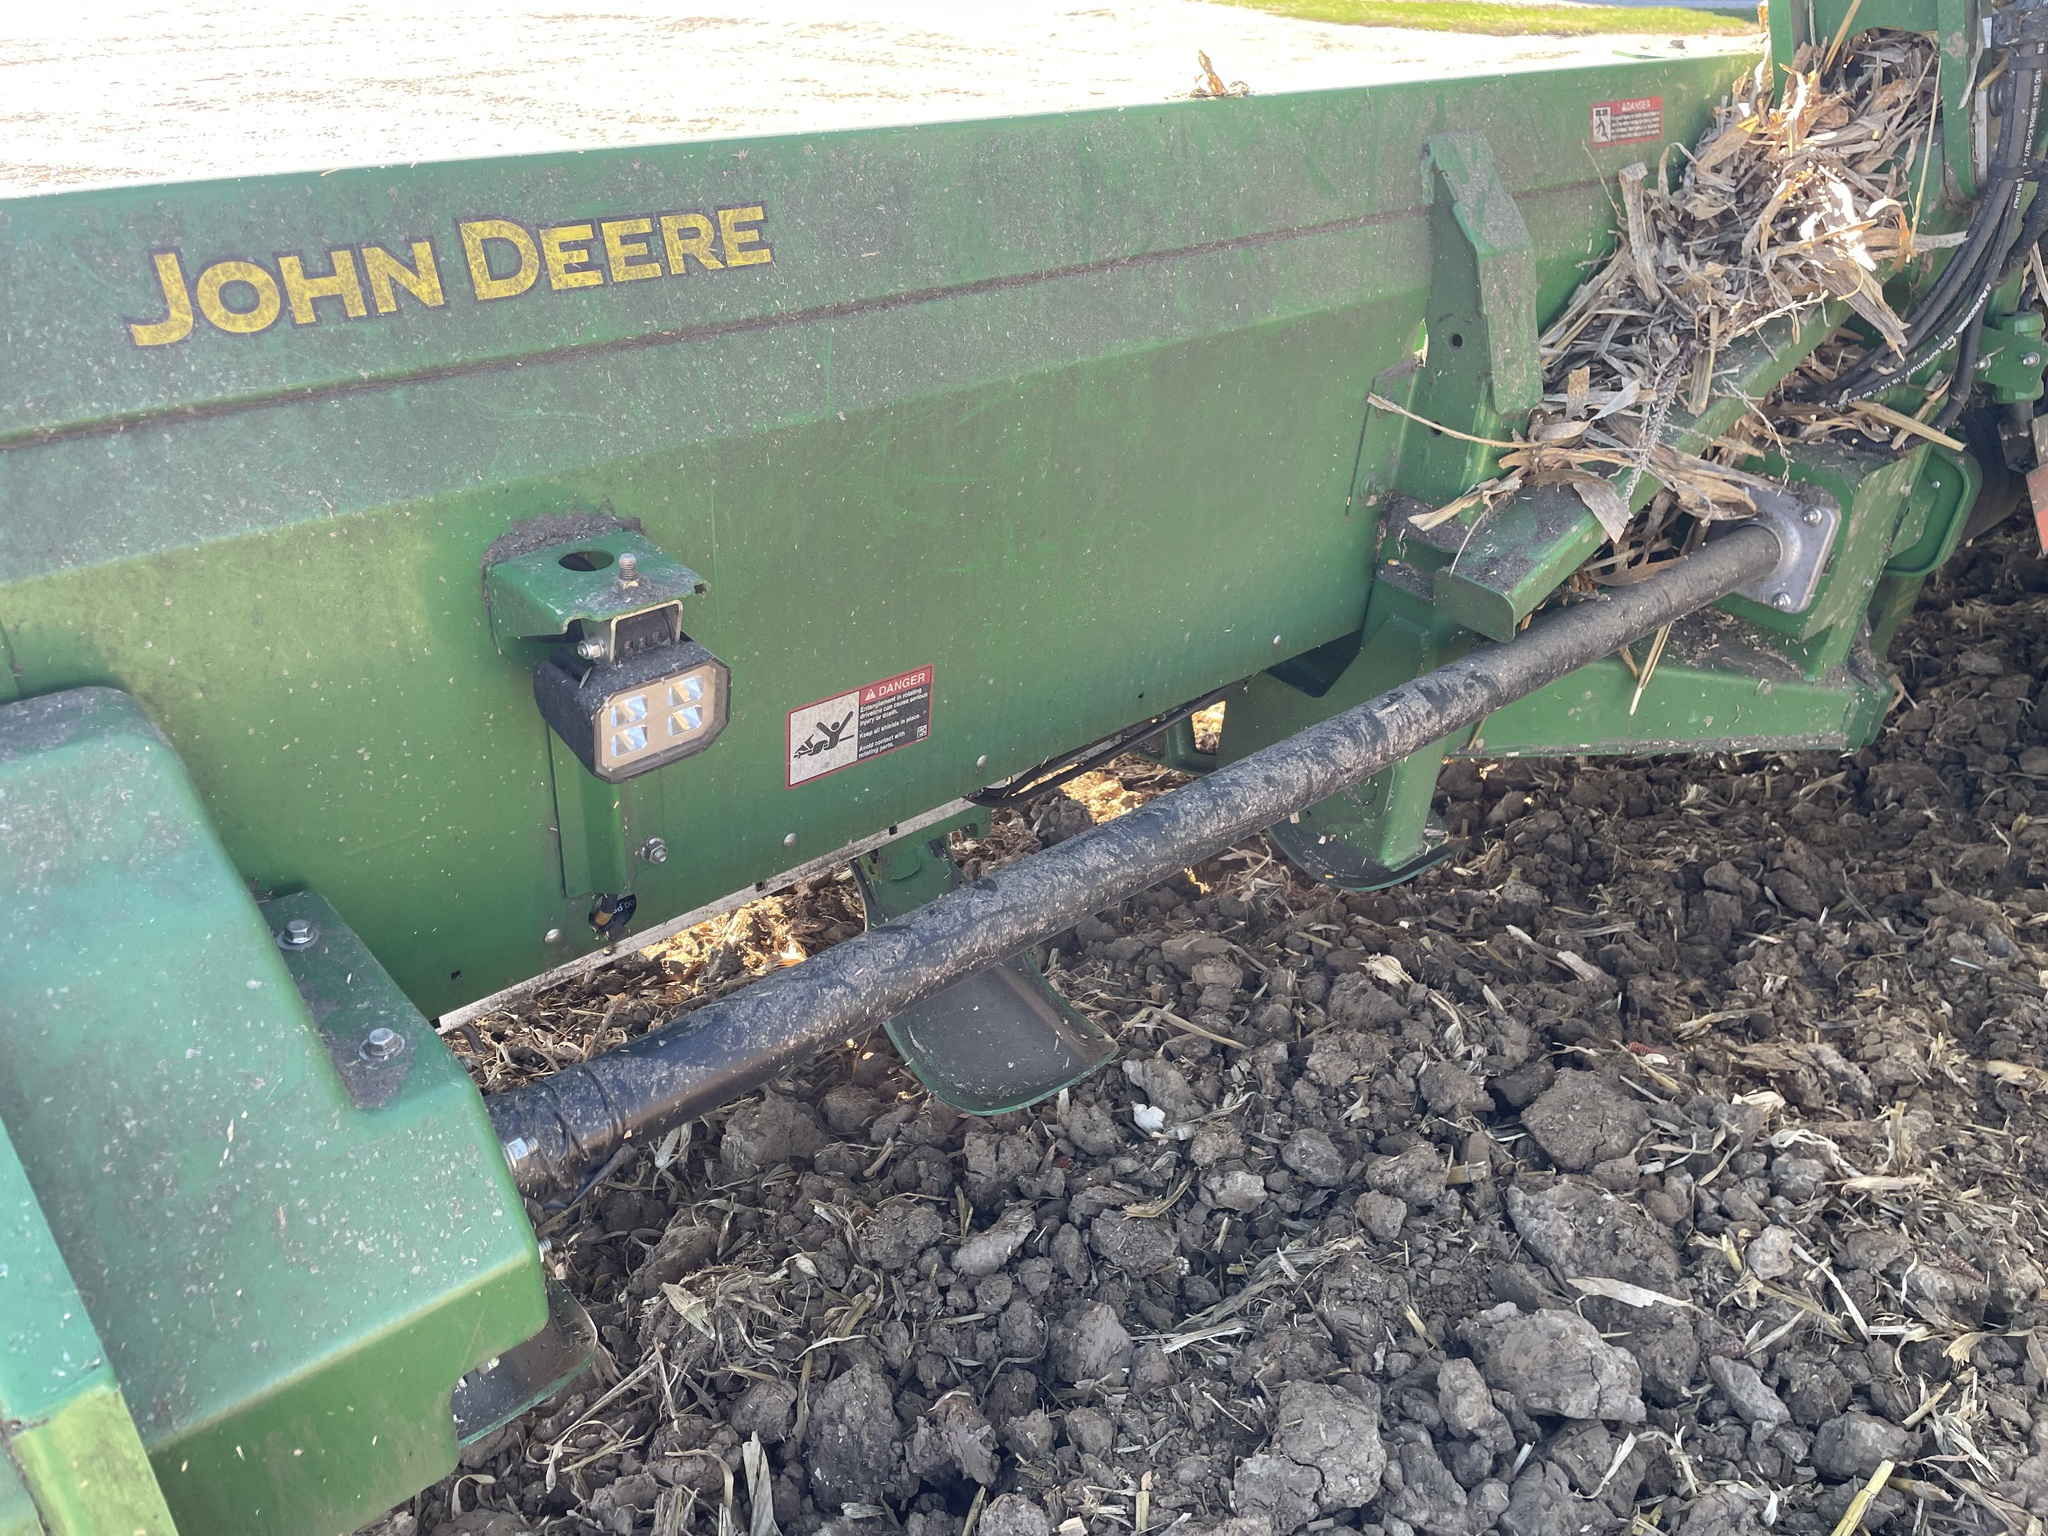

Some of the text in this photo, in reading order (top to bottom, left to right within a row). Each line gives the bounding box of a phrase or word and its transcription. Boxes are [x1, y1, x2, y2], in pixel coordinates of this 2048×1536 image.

[1627, 100, 1651, 111] DANGER
[2029, 107, 2038, 129] MSHA
[2013, 191, 2022, 209] ITALY
[130, 206, 772, 347] JOHN DEERE
[1955, 289, 1988, 334] ALFAGOMMA
[879, 673, 925, 697] DANGER
[860, 696, 896, 713] Entanglement
[902, 688, 922, 699] rotating
[860, 692, 928, 720] driveline can cause serious
[859, 717, 875, 727] injury
[860, 730, 873, 739] Keep
[906, 714, 921, 724] place.
[859, 731, 906, 752] Avoid contact with
[859, 742, 895, 759] rotating parts.
